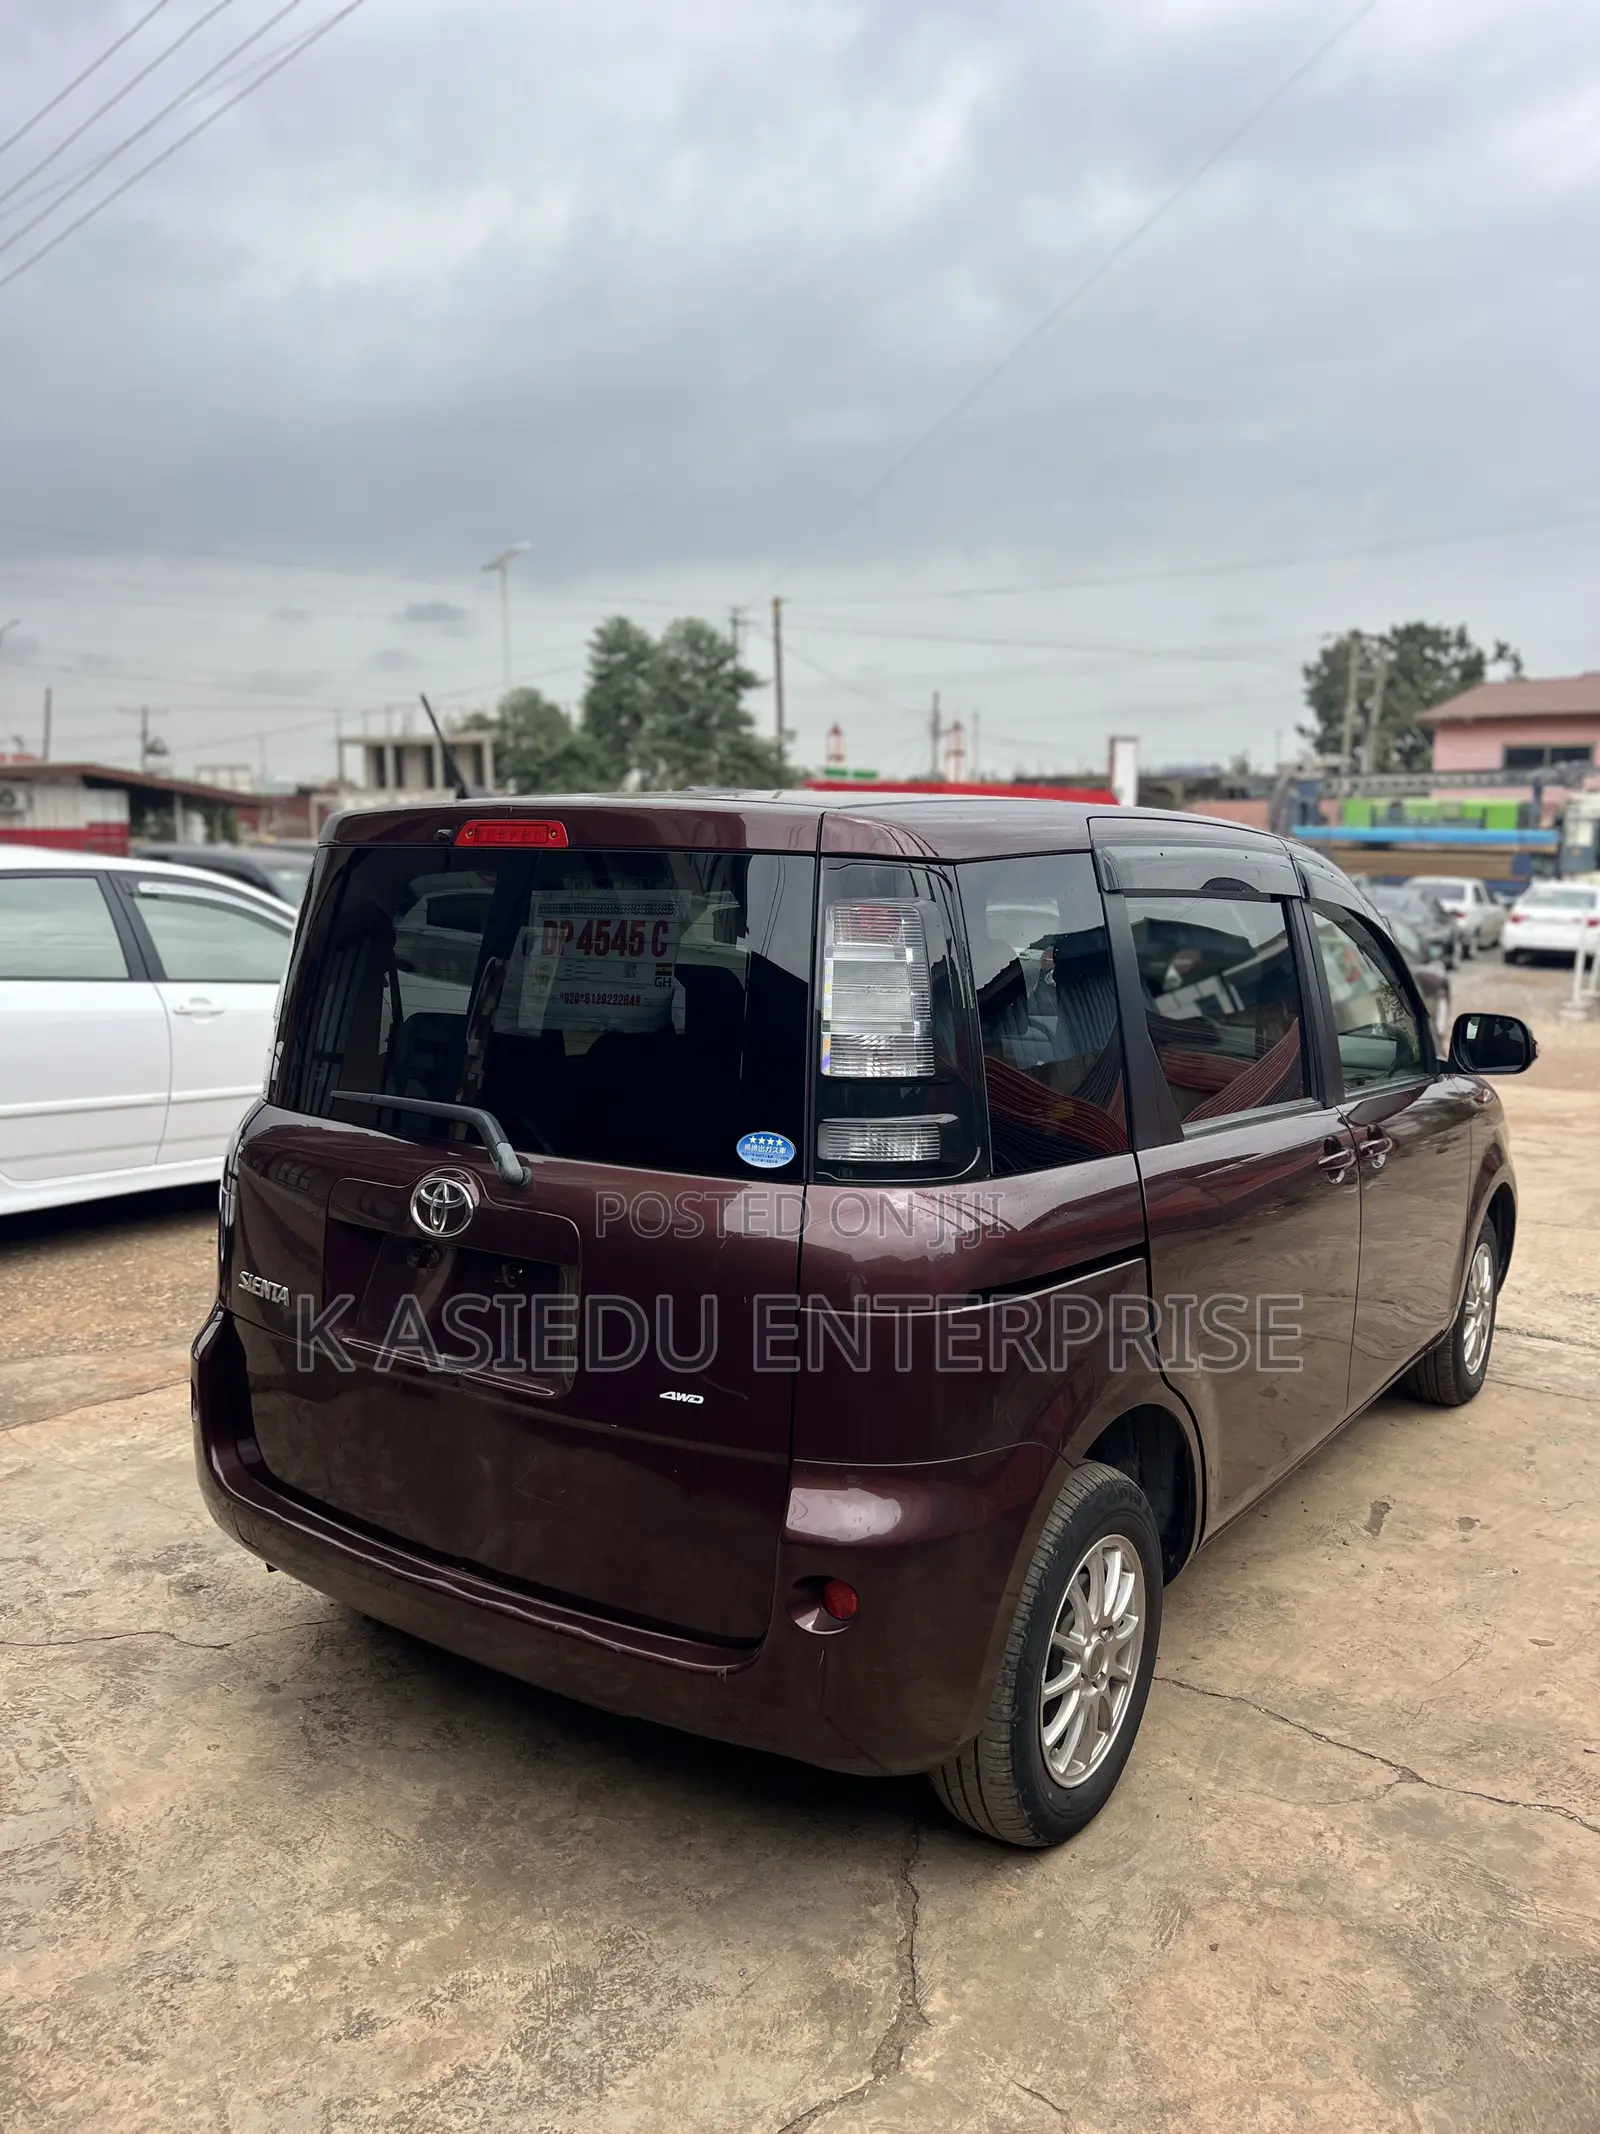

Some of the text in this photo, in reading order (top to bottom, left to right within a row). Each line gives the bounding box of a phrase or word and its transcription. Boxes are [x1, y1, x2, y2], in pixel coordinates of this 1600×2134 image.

[541, 919, 669, 957] DP 4545 C
[654, 976, 672, 988] GH
[238, 1270, 291, 1308] SIENTA
[659, 1391, 704, 1404] 4WD
